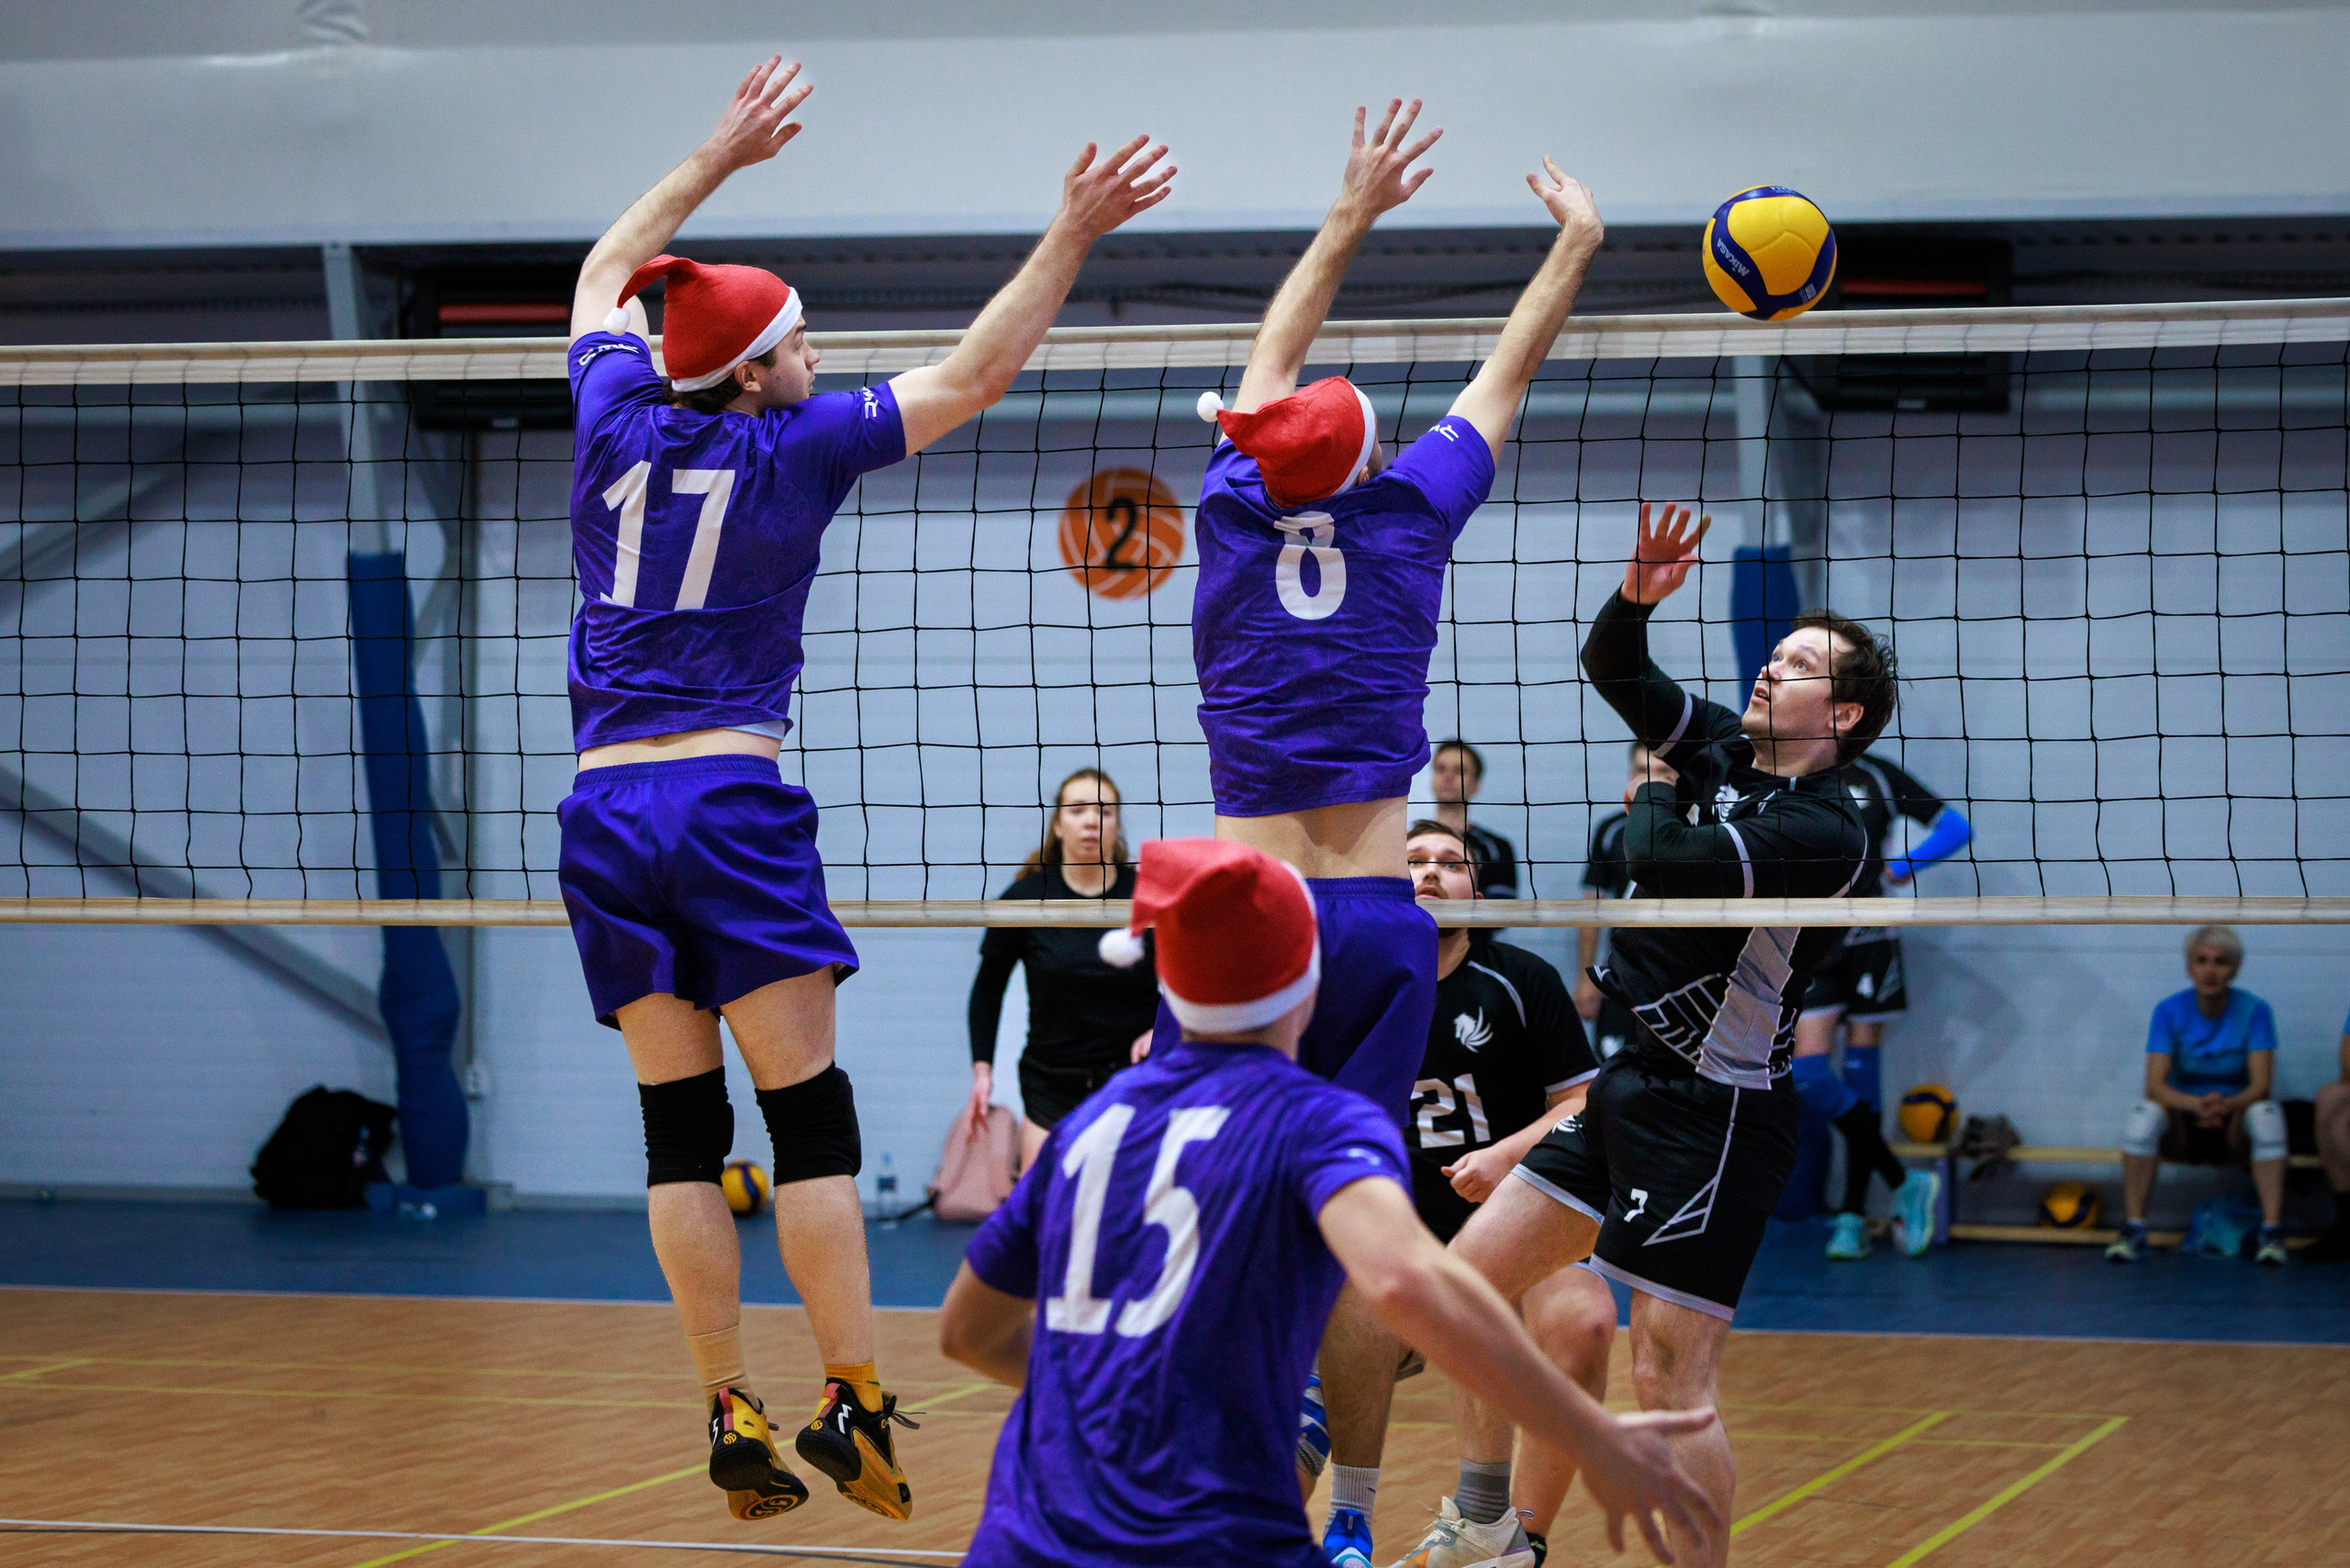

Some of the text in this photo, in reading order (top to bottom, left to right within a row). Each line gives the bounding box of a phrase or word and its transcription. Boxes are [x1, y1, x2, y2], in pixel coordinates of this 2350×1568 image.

[599, 460, 736, 612] 17
[1105, 497, 1139, 572] 2
[1273, 510, 1347, 621] 8
[1410, 1073, 1492, 1149] 21
[1045, 1103, 1232, 1338] 15
[1623, 1187, 1649, 1223] 7
